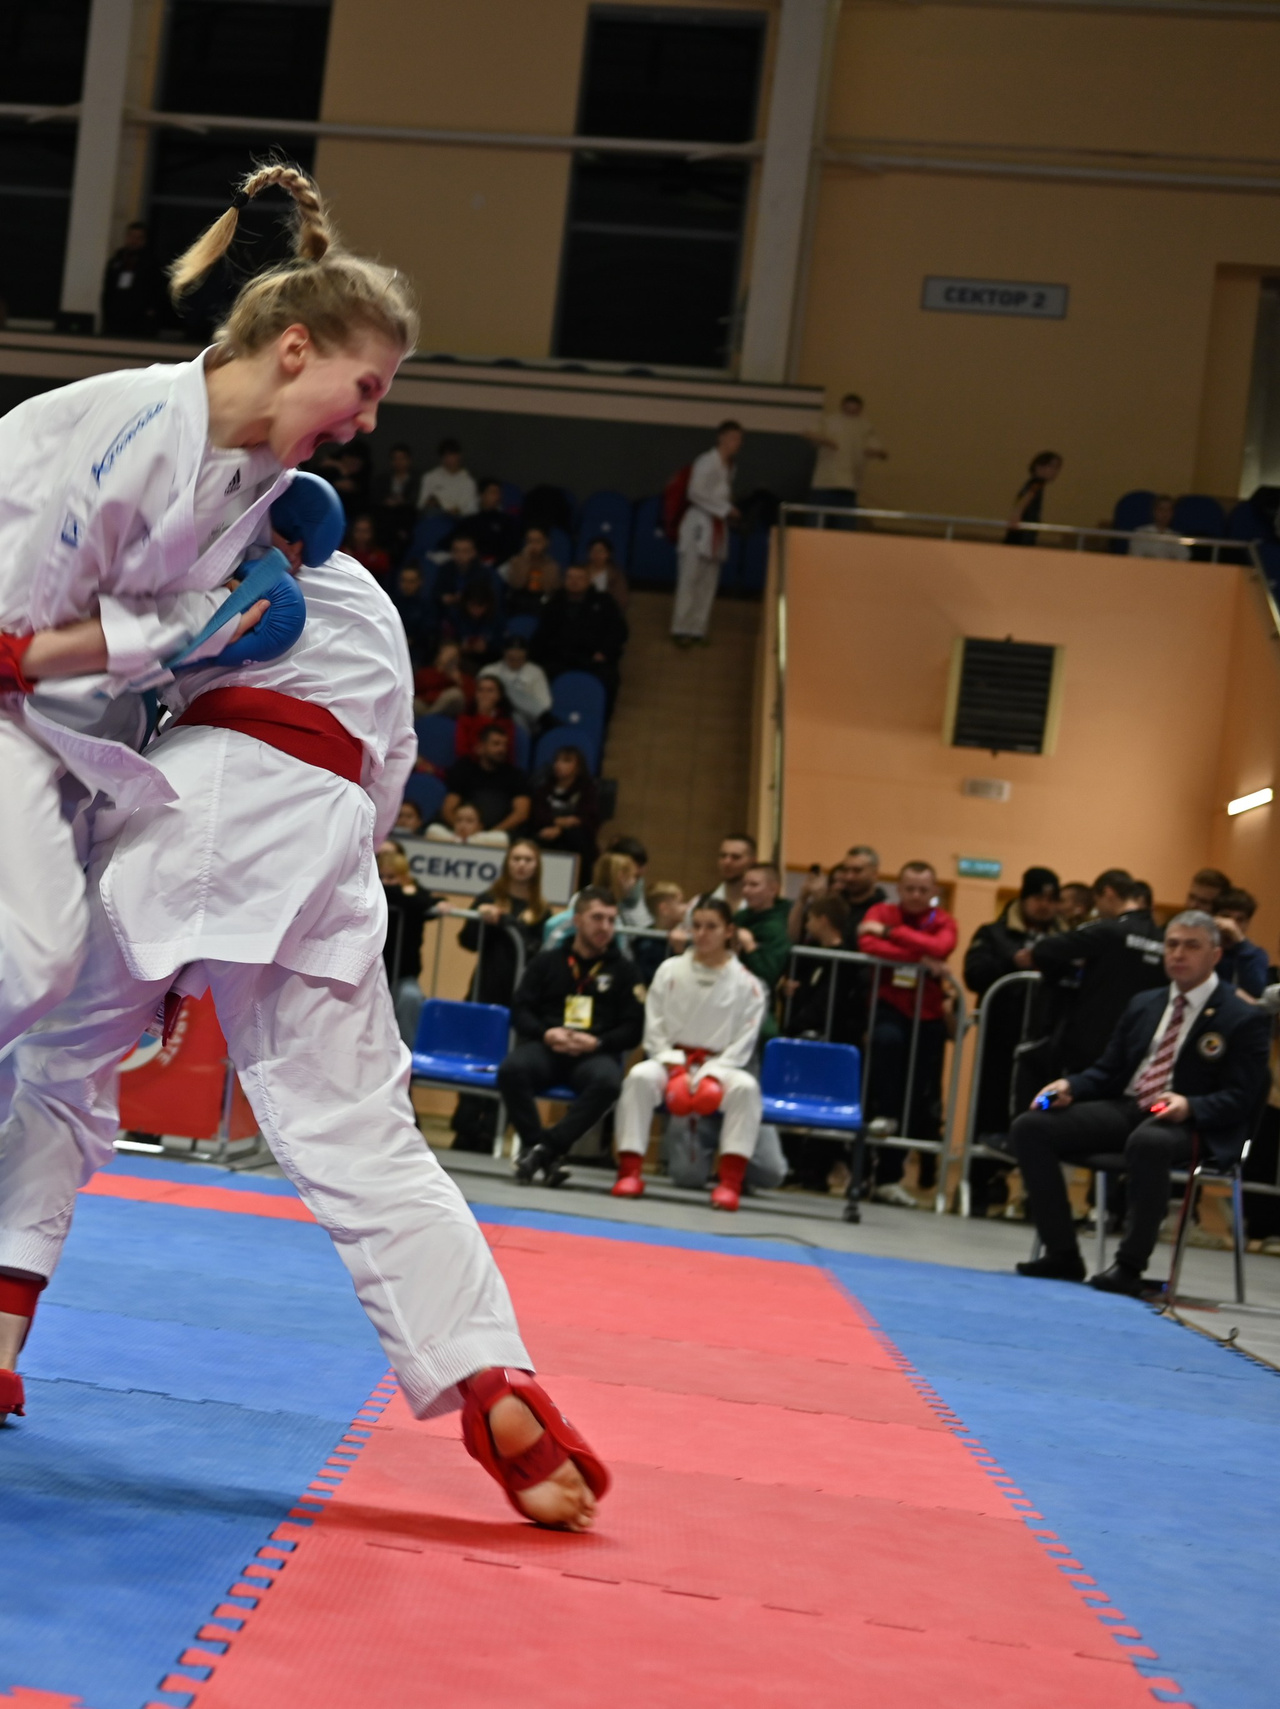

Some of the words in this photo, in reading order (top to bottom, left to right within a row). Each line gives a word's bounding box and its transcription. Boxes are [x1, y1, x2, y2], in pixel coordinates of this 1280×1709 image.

[944, 286, 1028, 307] СЕКТОР
[1033, 292, 1046, 309] 2
[410, 855, 498, 881] СЕКТО
